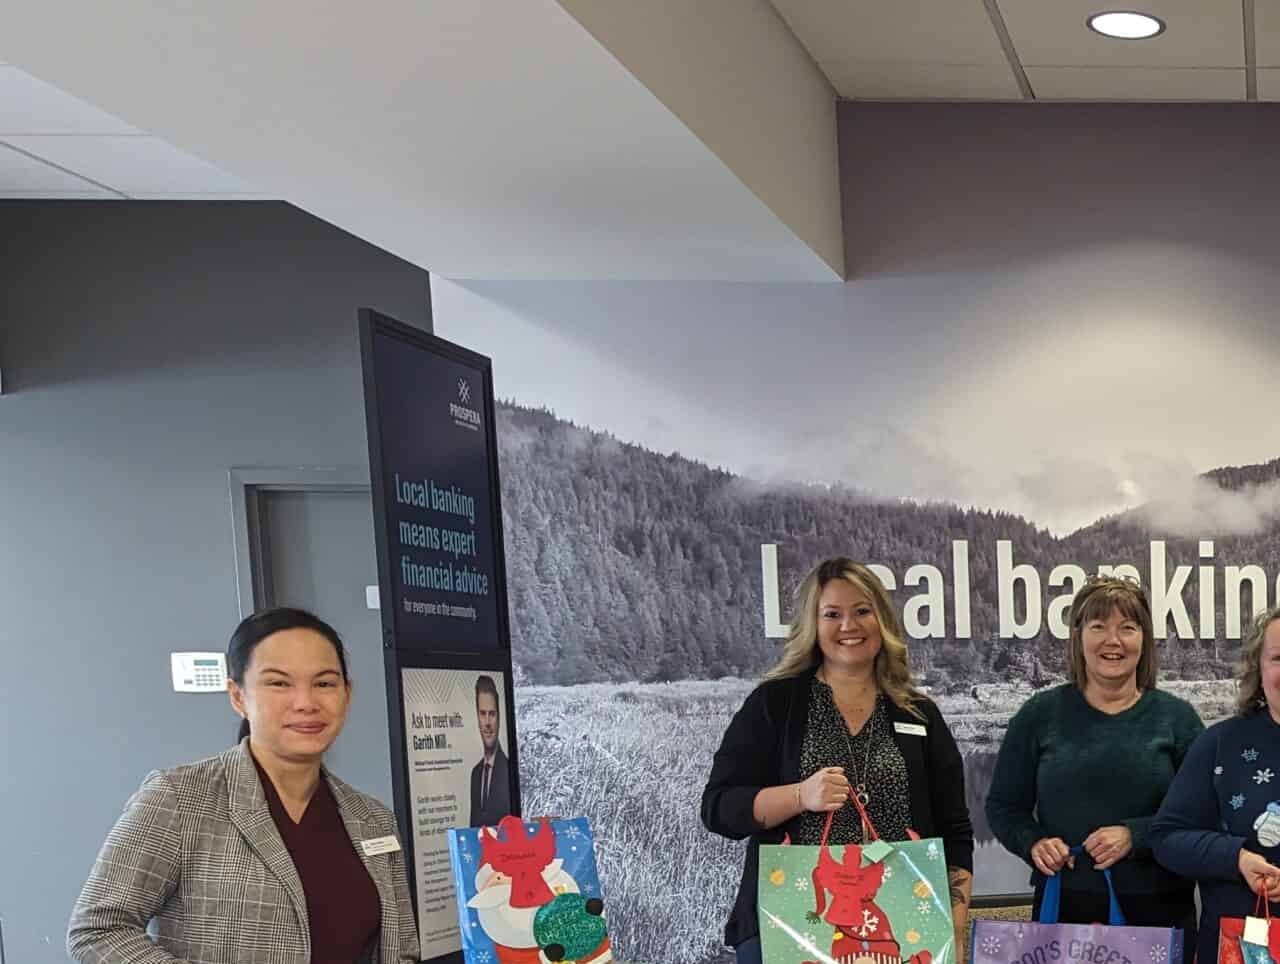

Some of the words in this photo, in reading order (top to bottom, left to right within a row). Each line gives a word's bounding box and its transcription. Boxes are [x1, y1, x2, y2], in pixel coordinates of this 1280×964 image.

[395, 472, 429, 509] Local
[431, 479, 475, 525] banking
[399, 520, 440, 550] means
[441, 529, 477, 560] expert
[402, 555, 453, 592] financial
[455, 565, 489, 595] advice
[761, 539, 971, 640] Lal
[411, 711, 424, 729] Ask
